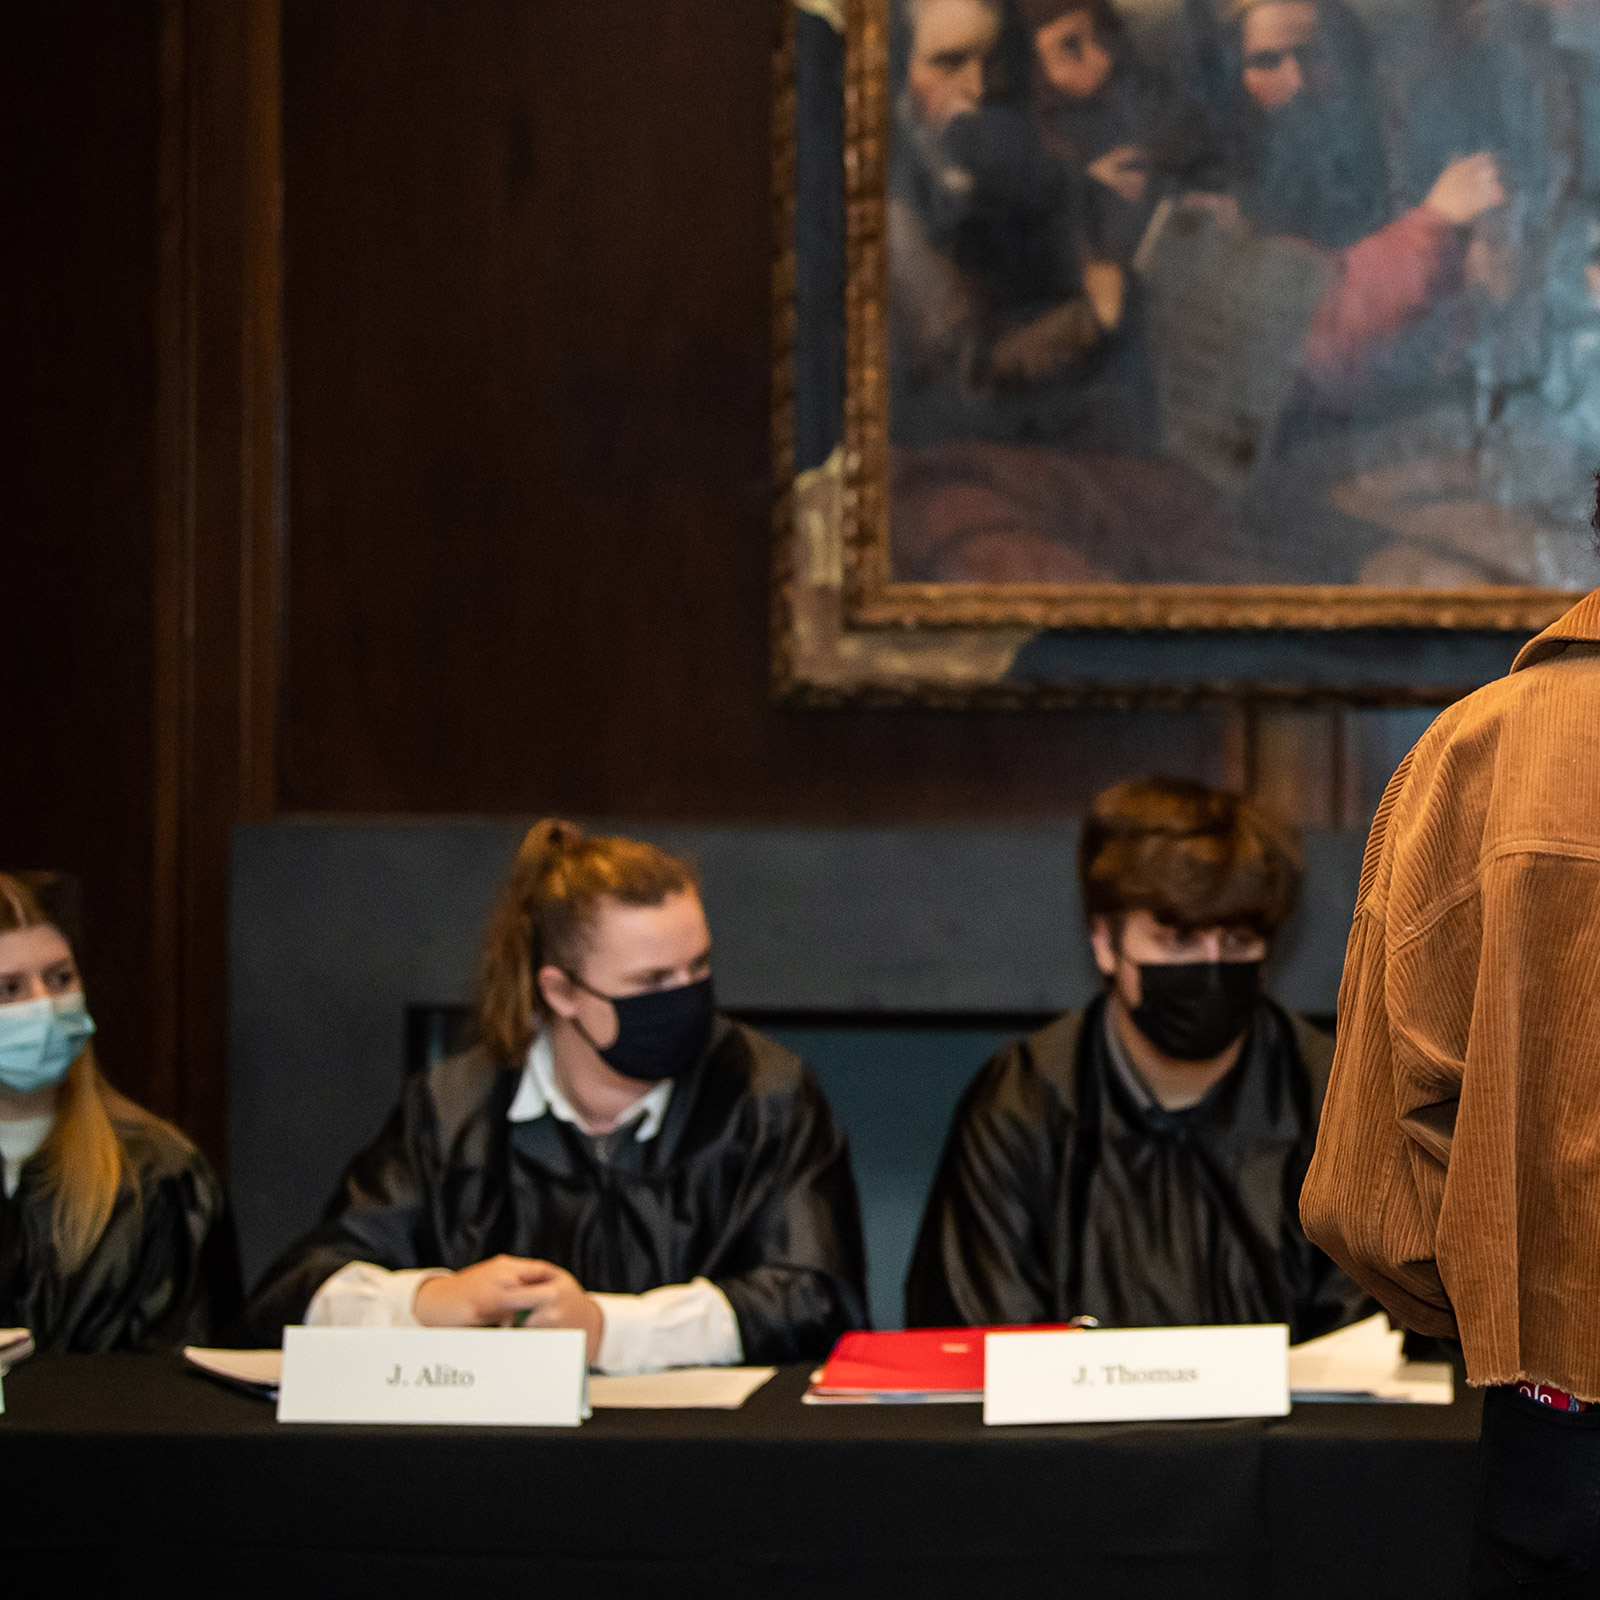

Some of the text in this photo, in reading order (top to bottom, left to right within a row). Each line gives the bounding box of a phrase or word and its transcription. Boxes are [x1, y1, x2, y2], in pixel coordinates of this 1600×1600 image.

[385, 1364, 475, 1388] J. Alito
[1072, 1364, 1198, 1386] J. Thomas
